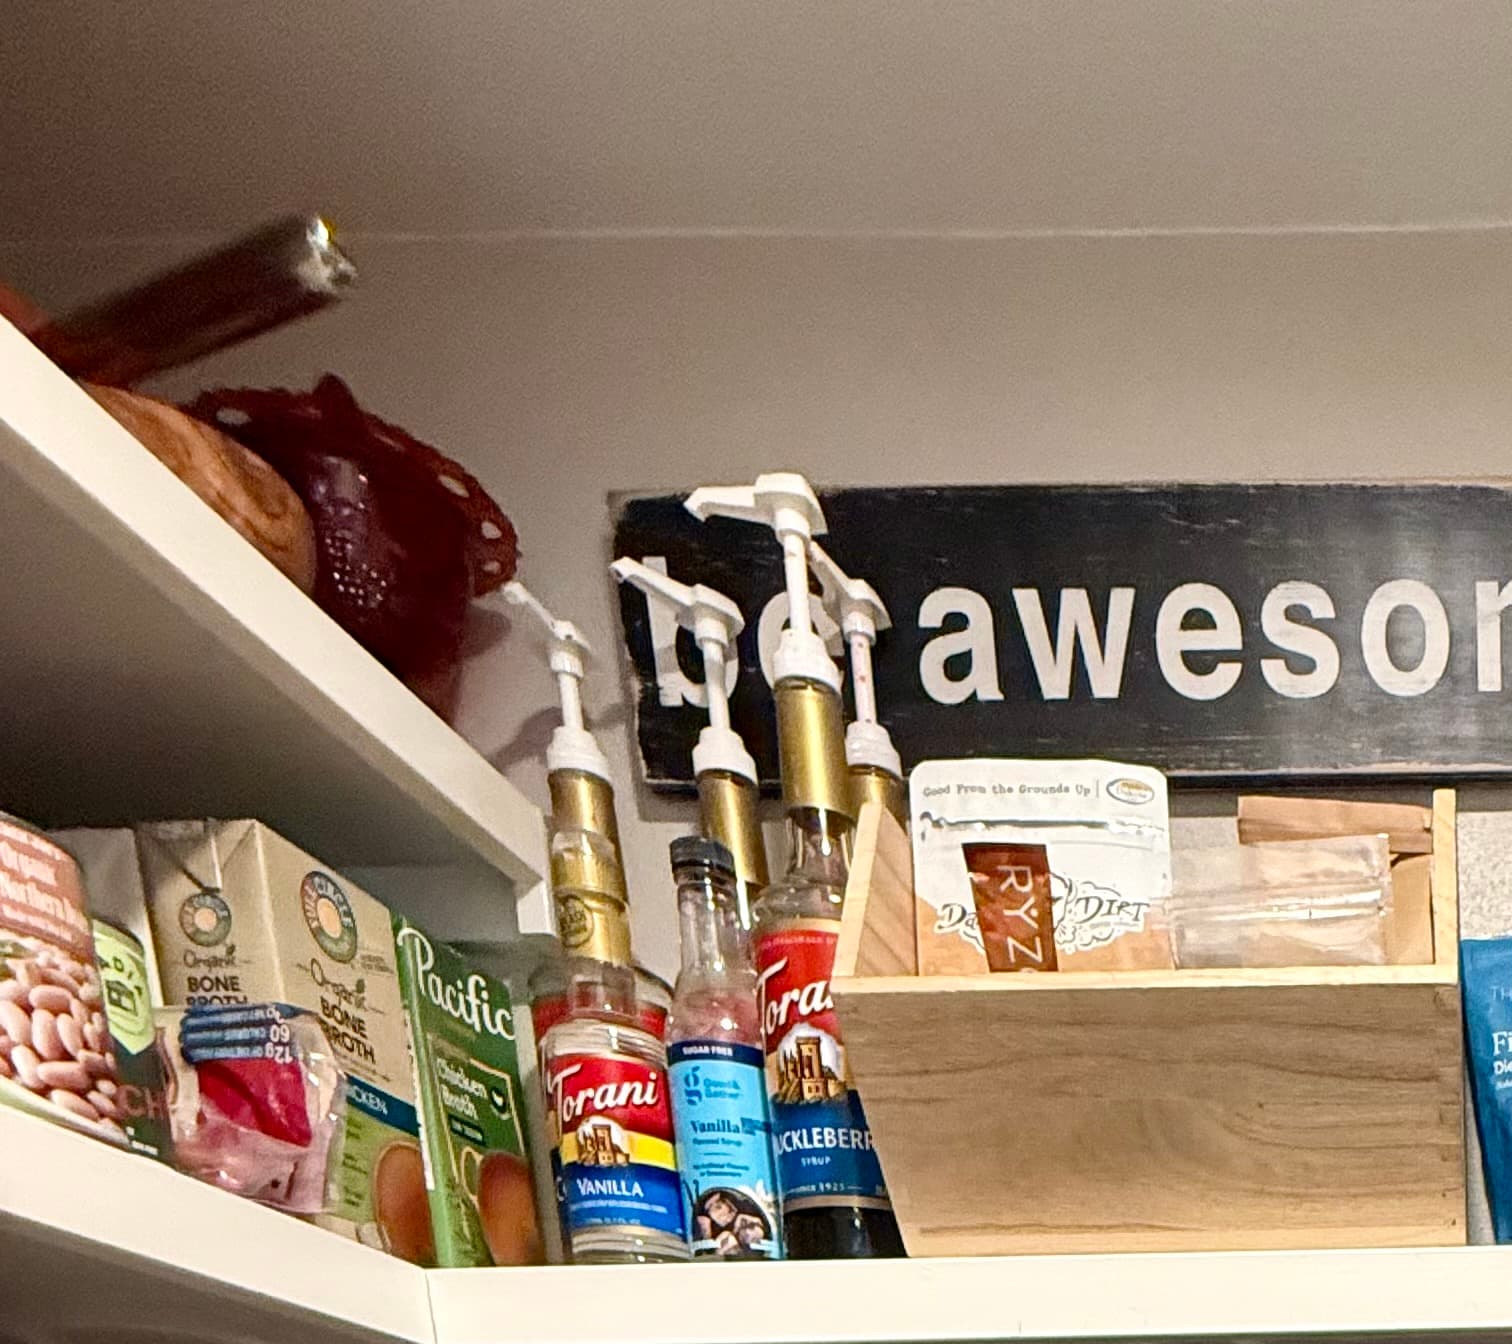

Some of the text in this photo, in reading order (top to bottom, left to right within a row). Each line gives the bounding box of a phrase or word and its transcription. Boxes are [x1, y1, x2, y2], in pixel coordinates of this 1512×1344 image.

[923, 784, 951, 797] Good
[992, 783, 1014, 794] the
[1018, 782, 1070, 795] Grounds
[1075, 782, 1091, 796] Up
[1075, 895, 1151, 925] DIRT
[187, 975, 240, 993] BONE
[396, 926, 516, 1041] Pacific
[755, 957, 835, 1037] Tora
[320, 996, 368, 1039] BONE
[548, 1062, 658, 1123] Torani
[690, 1119, 741, 1135] Vanilla
[772, 1126, 875, 1157] UCKLEBERR
[577, 1176, 644, 1199] VANILLA
